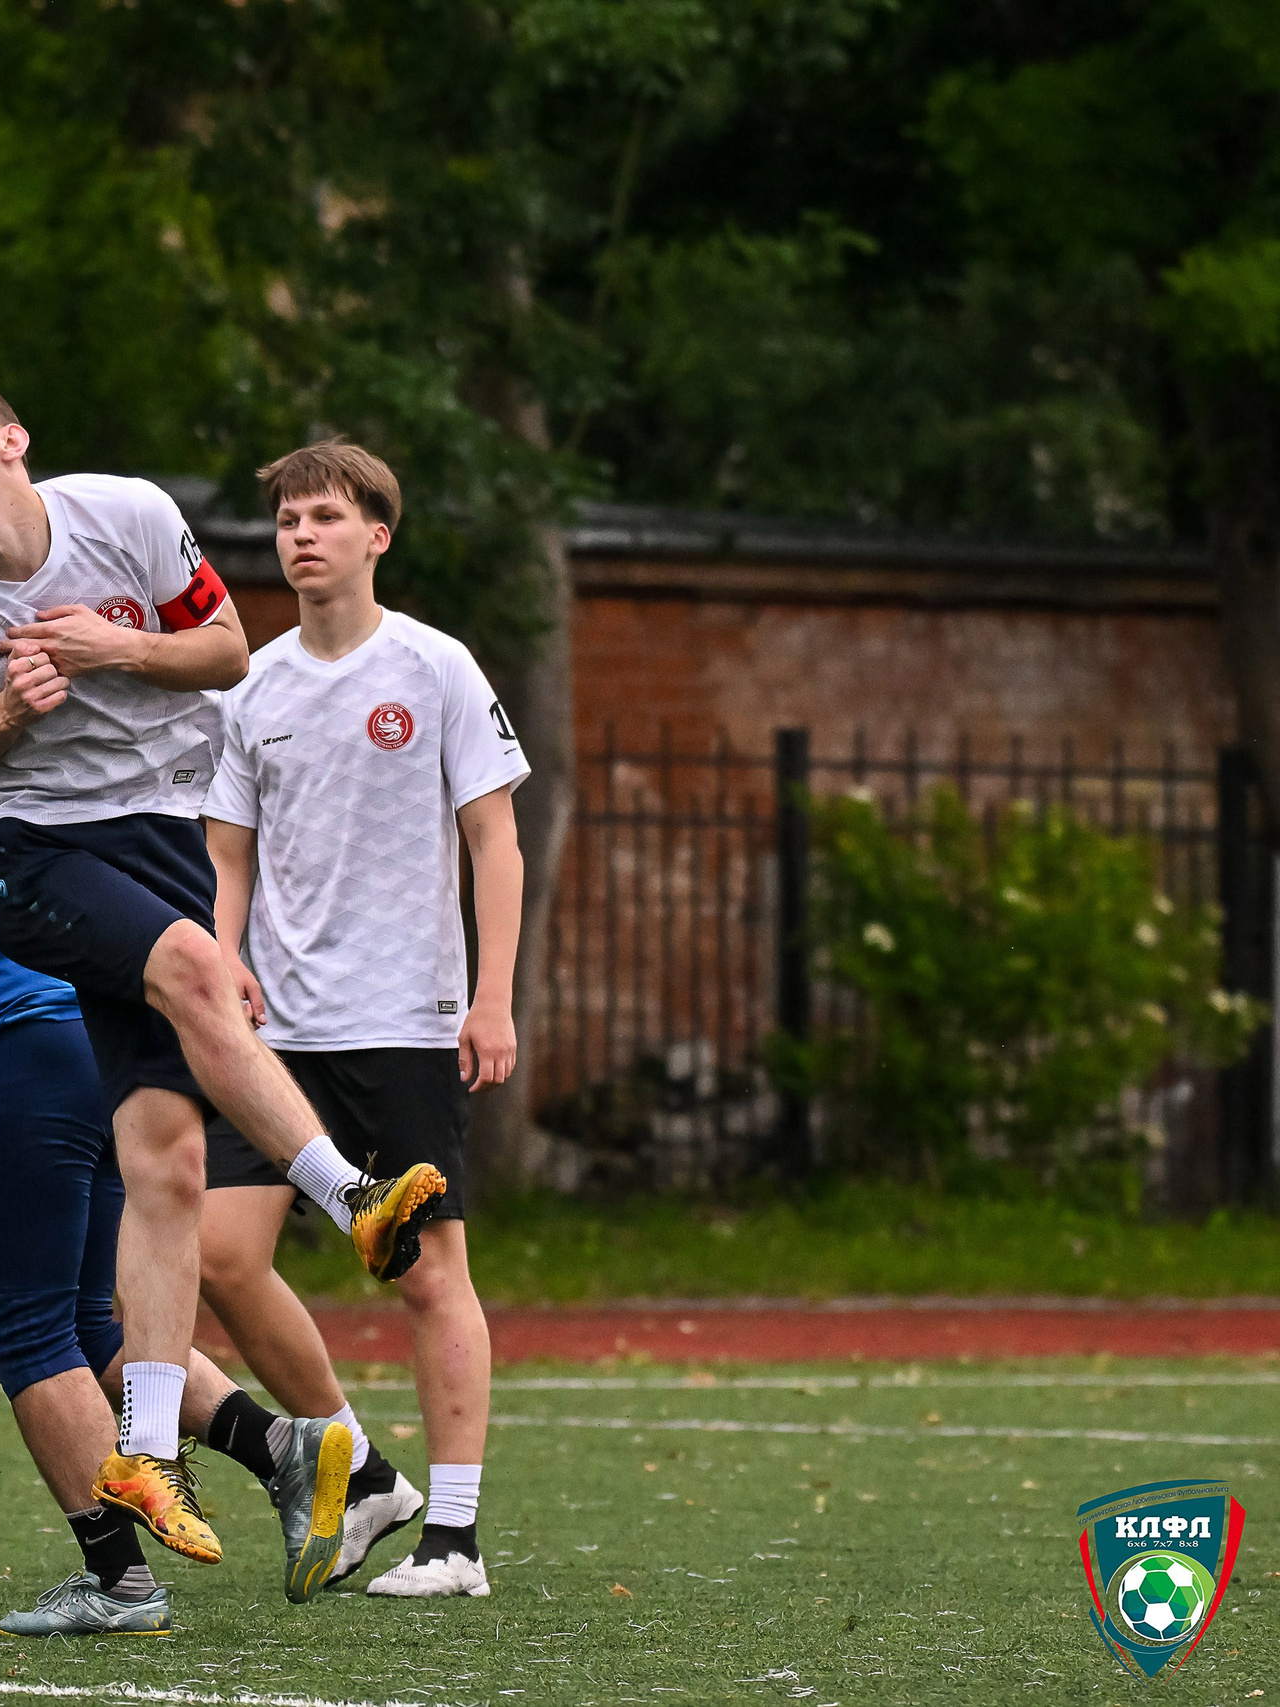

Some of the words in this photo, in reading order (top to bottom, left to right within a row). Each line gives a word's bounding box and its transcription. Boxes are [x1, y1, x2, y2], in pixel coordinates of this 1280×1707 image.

[100, 598, 127, 611] PHOENIX
[182, 577, 217, 620] C
[271, 734, 293, 744] SPORT
